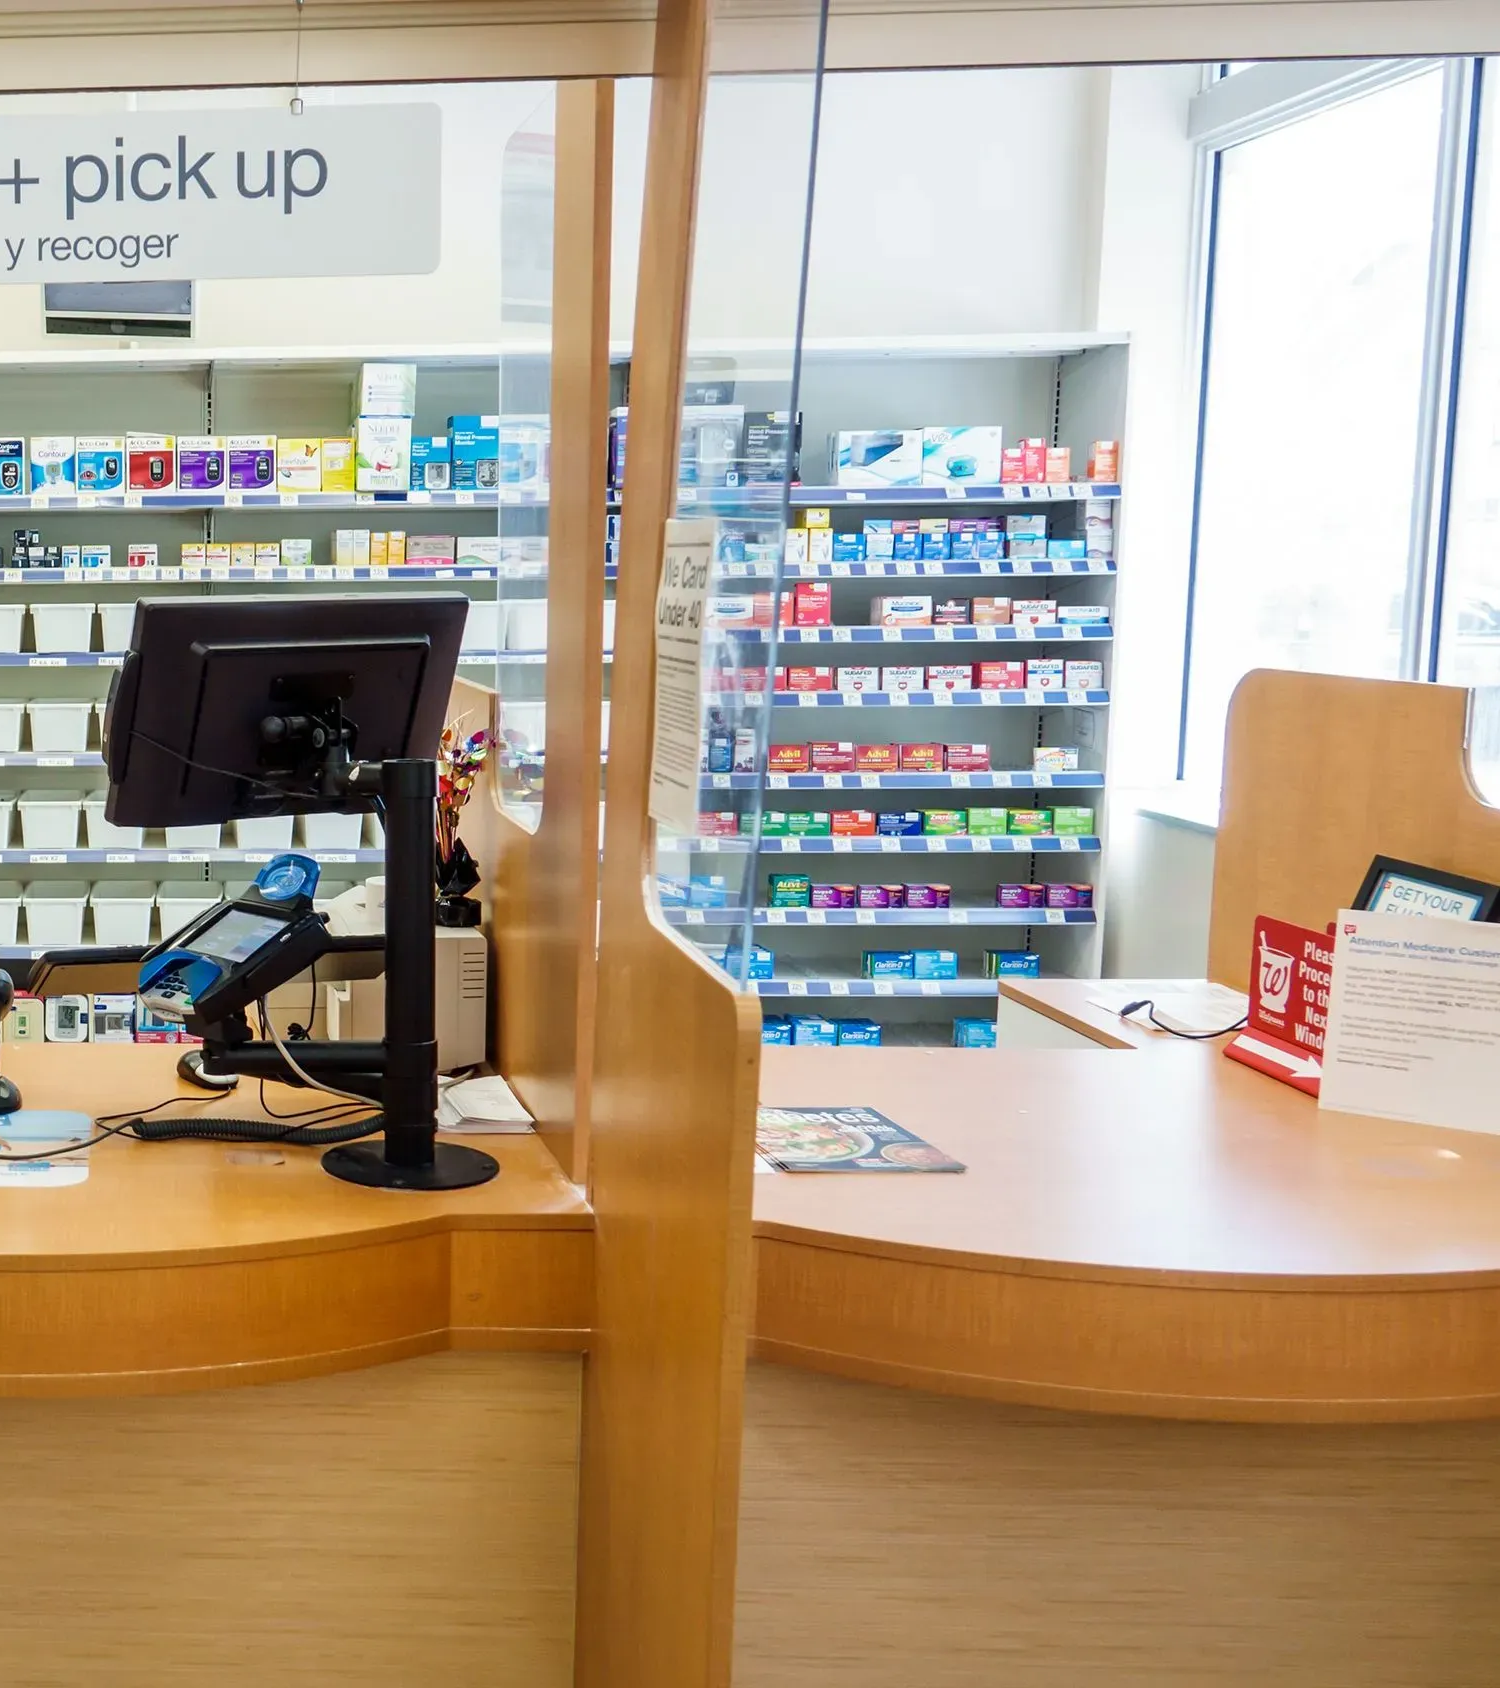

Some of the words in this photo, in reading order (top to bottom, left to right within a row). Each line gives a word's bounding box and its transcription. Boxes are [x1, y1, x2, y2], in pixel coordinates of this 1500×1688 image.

[66, 136, 216, 220] pick
[237, 149, 327, 214] up
[5, 238, 25, 271] y
[39, 234, 178, 268] recoger
[38, 450, 68, 458] Contour
[666, 556, 680, 589] We
[680, 556, 708, 590] Card
[658, 597, 686, 627] Under
[688, 600, 701, 629] 40
[777, 750, 801, 758] Advil
[865, 750, 890, 758] Advil
[911, 749, 934, 757] Advil
[1393, 885, 1422, 904] GET
[1422, 892, 1463, 915] YOUR
[1304, 941, 1335, 967] Pleas
[1349, 937, 1399, 949] Attention
[1403, 942, 1455, 955] Medicare
[874, 960, 903, 969] Claritin-D
[1000, 960, 1029, 969] Claritin-D
[1299, 961, 1330, 987] Proce
[1303, 984, 1315, 1003] to
[1317, 989, 1329, 1008] th
[1305, 1006, 1327, 1028] Nex
[761, 1031, 780, 1040] ritin-D
[1294, 1022, 1323, 1049] Wind
